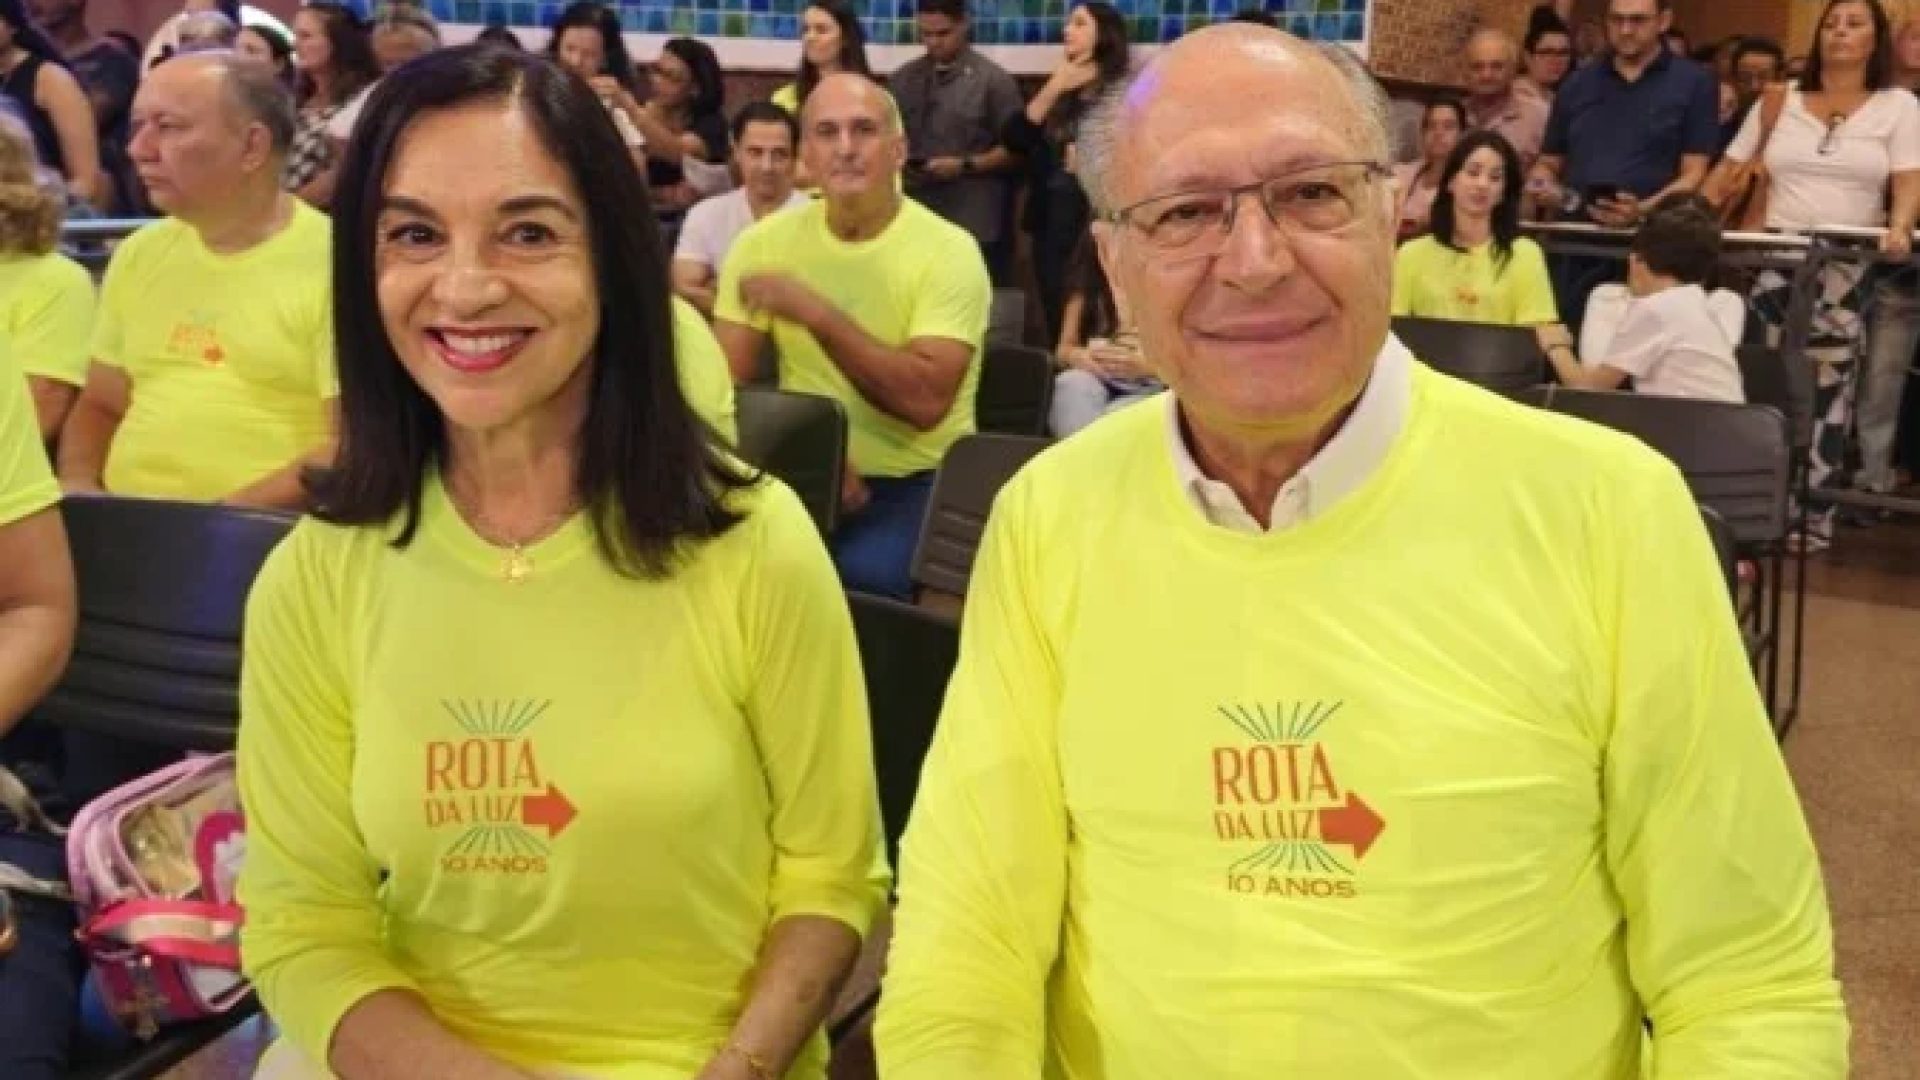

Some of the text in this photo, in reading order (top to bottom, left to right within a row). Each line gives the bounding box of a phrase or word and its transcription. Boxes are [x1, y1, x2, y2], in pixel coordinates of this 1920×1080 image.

[426, 738, 541, 793] ROTA
[1212, 741, 1339, 804] ROTA
[424, 794, 519, 828] DA LUZ
[1214, 809, 1315, 839] DA LUZ
[441, 855, 547, 873] 10 ANOS
[1228, 875, 1357, 898] 10 ANOS
